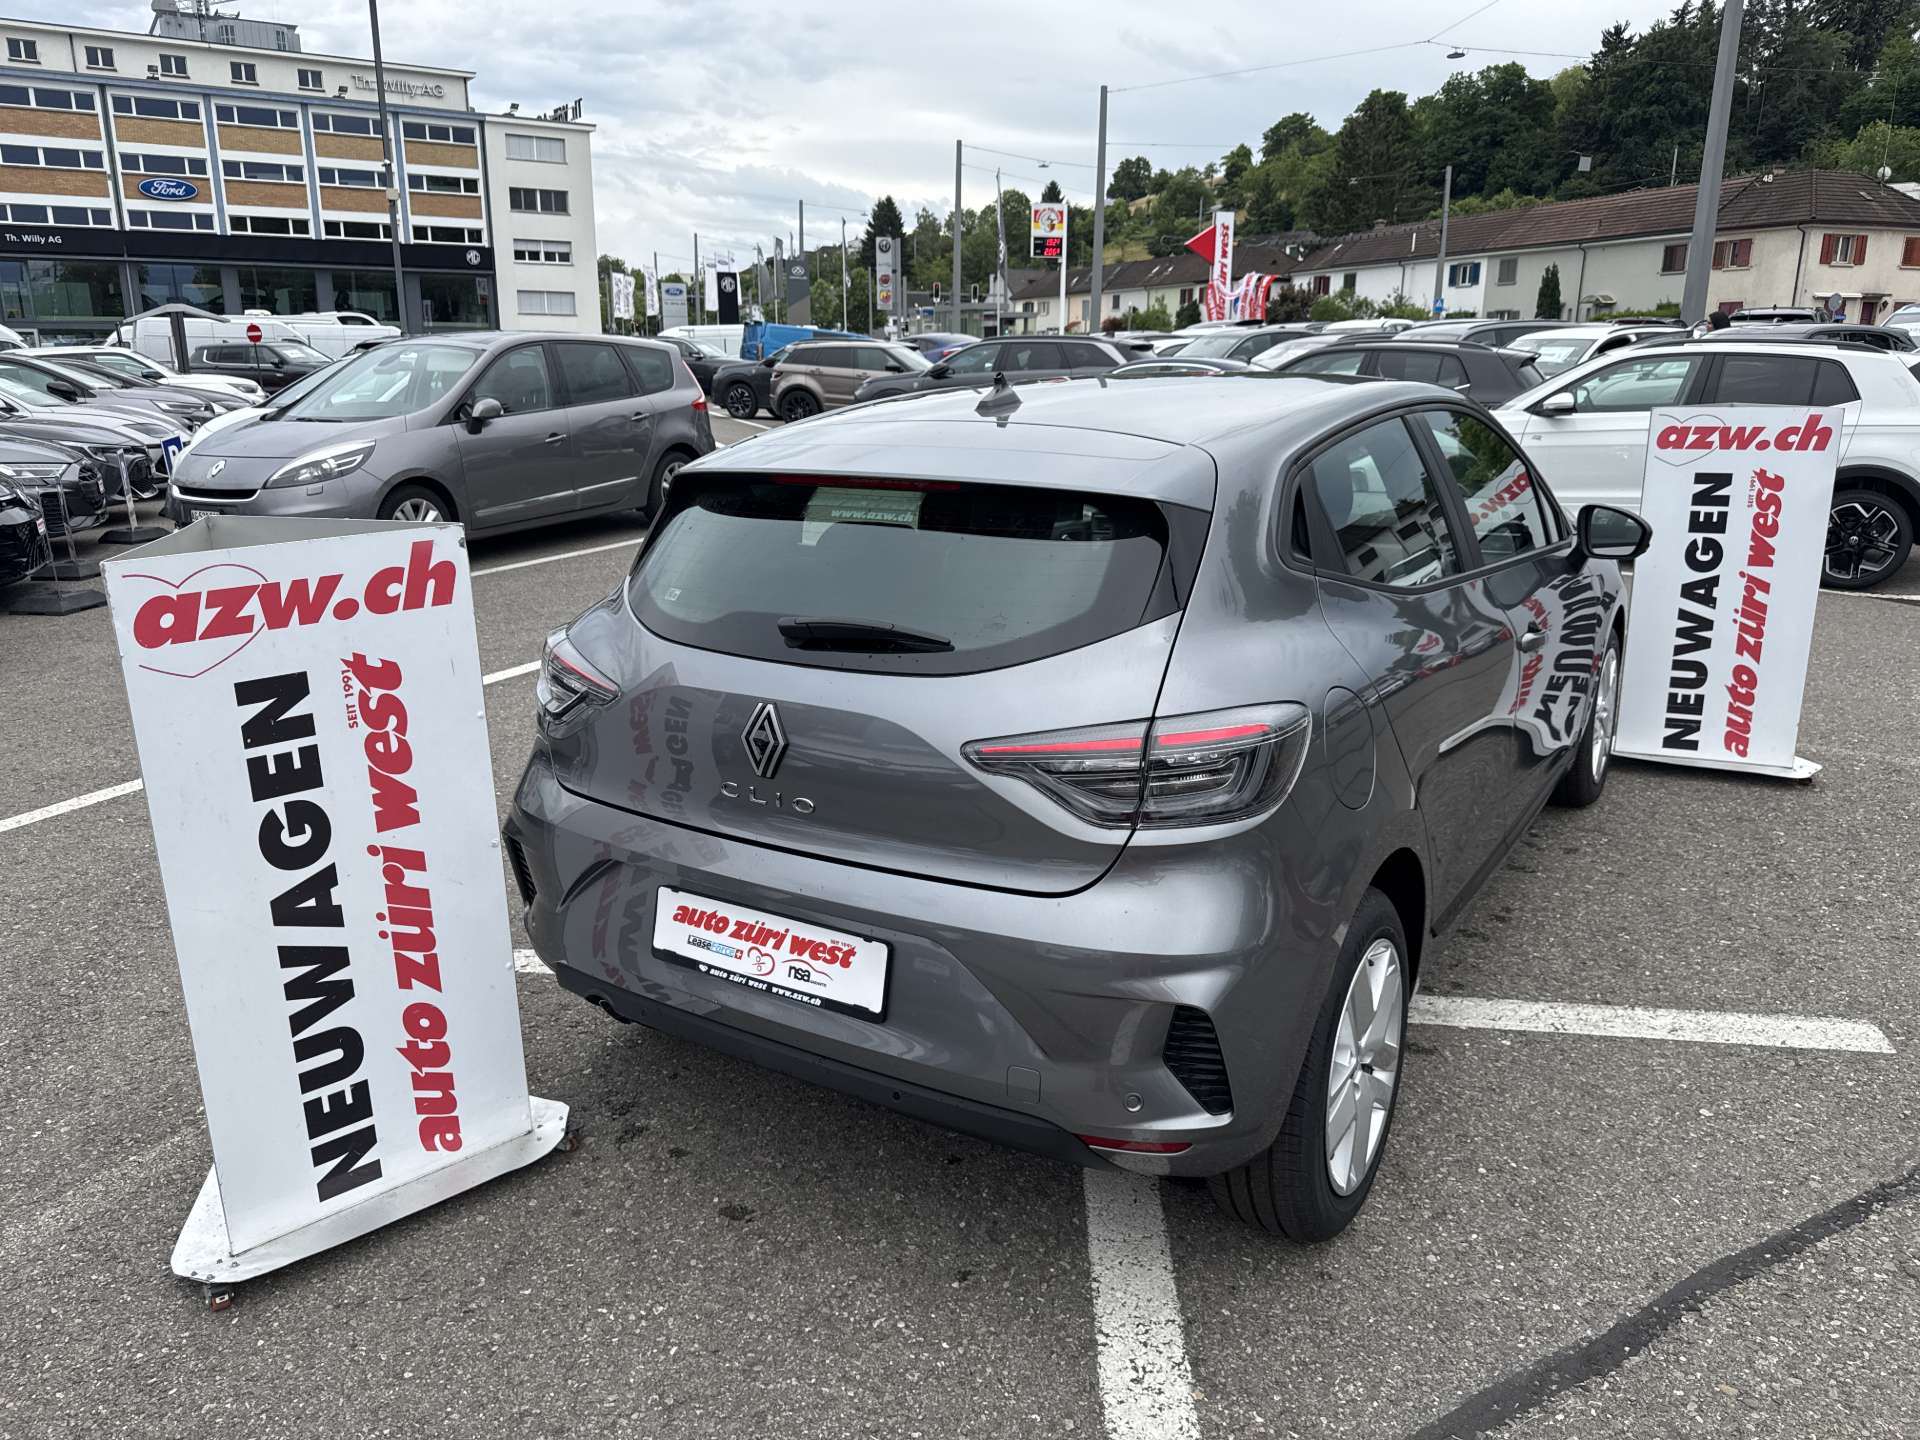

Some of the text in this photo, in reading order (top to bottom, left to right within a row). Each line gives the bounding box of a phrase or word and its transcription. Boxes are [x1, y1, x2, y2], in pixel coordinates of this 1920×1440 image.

[420, 83, 445, 97] AG
[151, 180, 187, 197] Ford
[1762, 174, 1773, 183] 48
[5, 233, 62, 244] Th. Willy AG
[466, 250, 480, 265] MG
[721, 277, 735, 293] MG
[1656, 413, 1835, 452] azw.ch
[132, 540, 457, 650] azw.ch
[1662, 471, 1734, 752] NEUWAGEN
[1723, 468, 1786, 759] auto züri west
[341, 667, 359, 730] SEIT 1991
[720, 781, 815, 813] CLIO
[341, 651, 463, 1154] auto züri west
[233, 669, 383, 1203] NEUWAGEN
[672, 905, 857, 969] auto züri west
[709, 968, 728, 979] auto
[729, 973, 746, 985] züri
[748, 979, 767, 991] west
[787, 964, 811, 983] nsa
